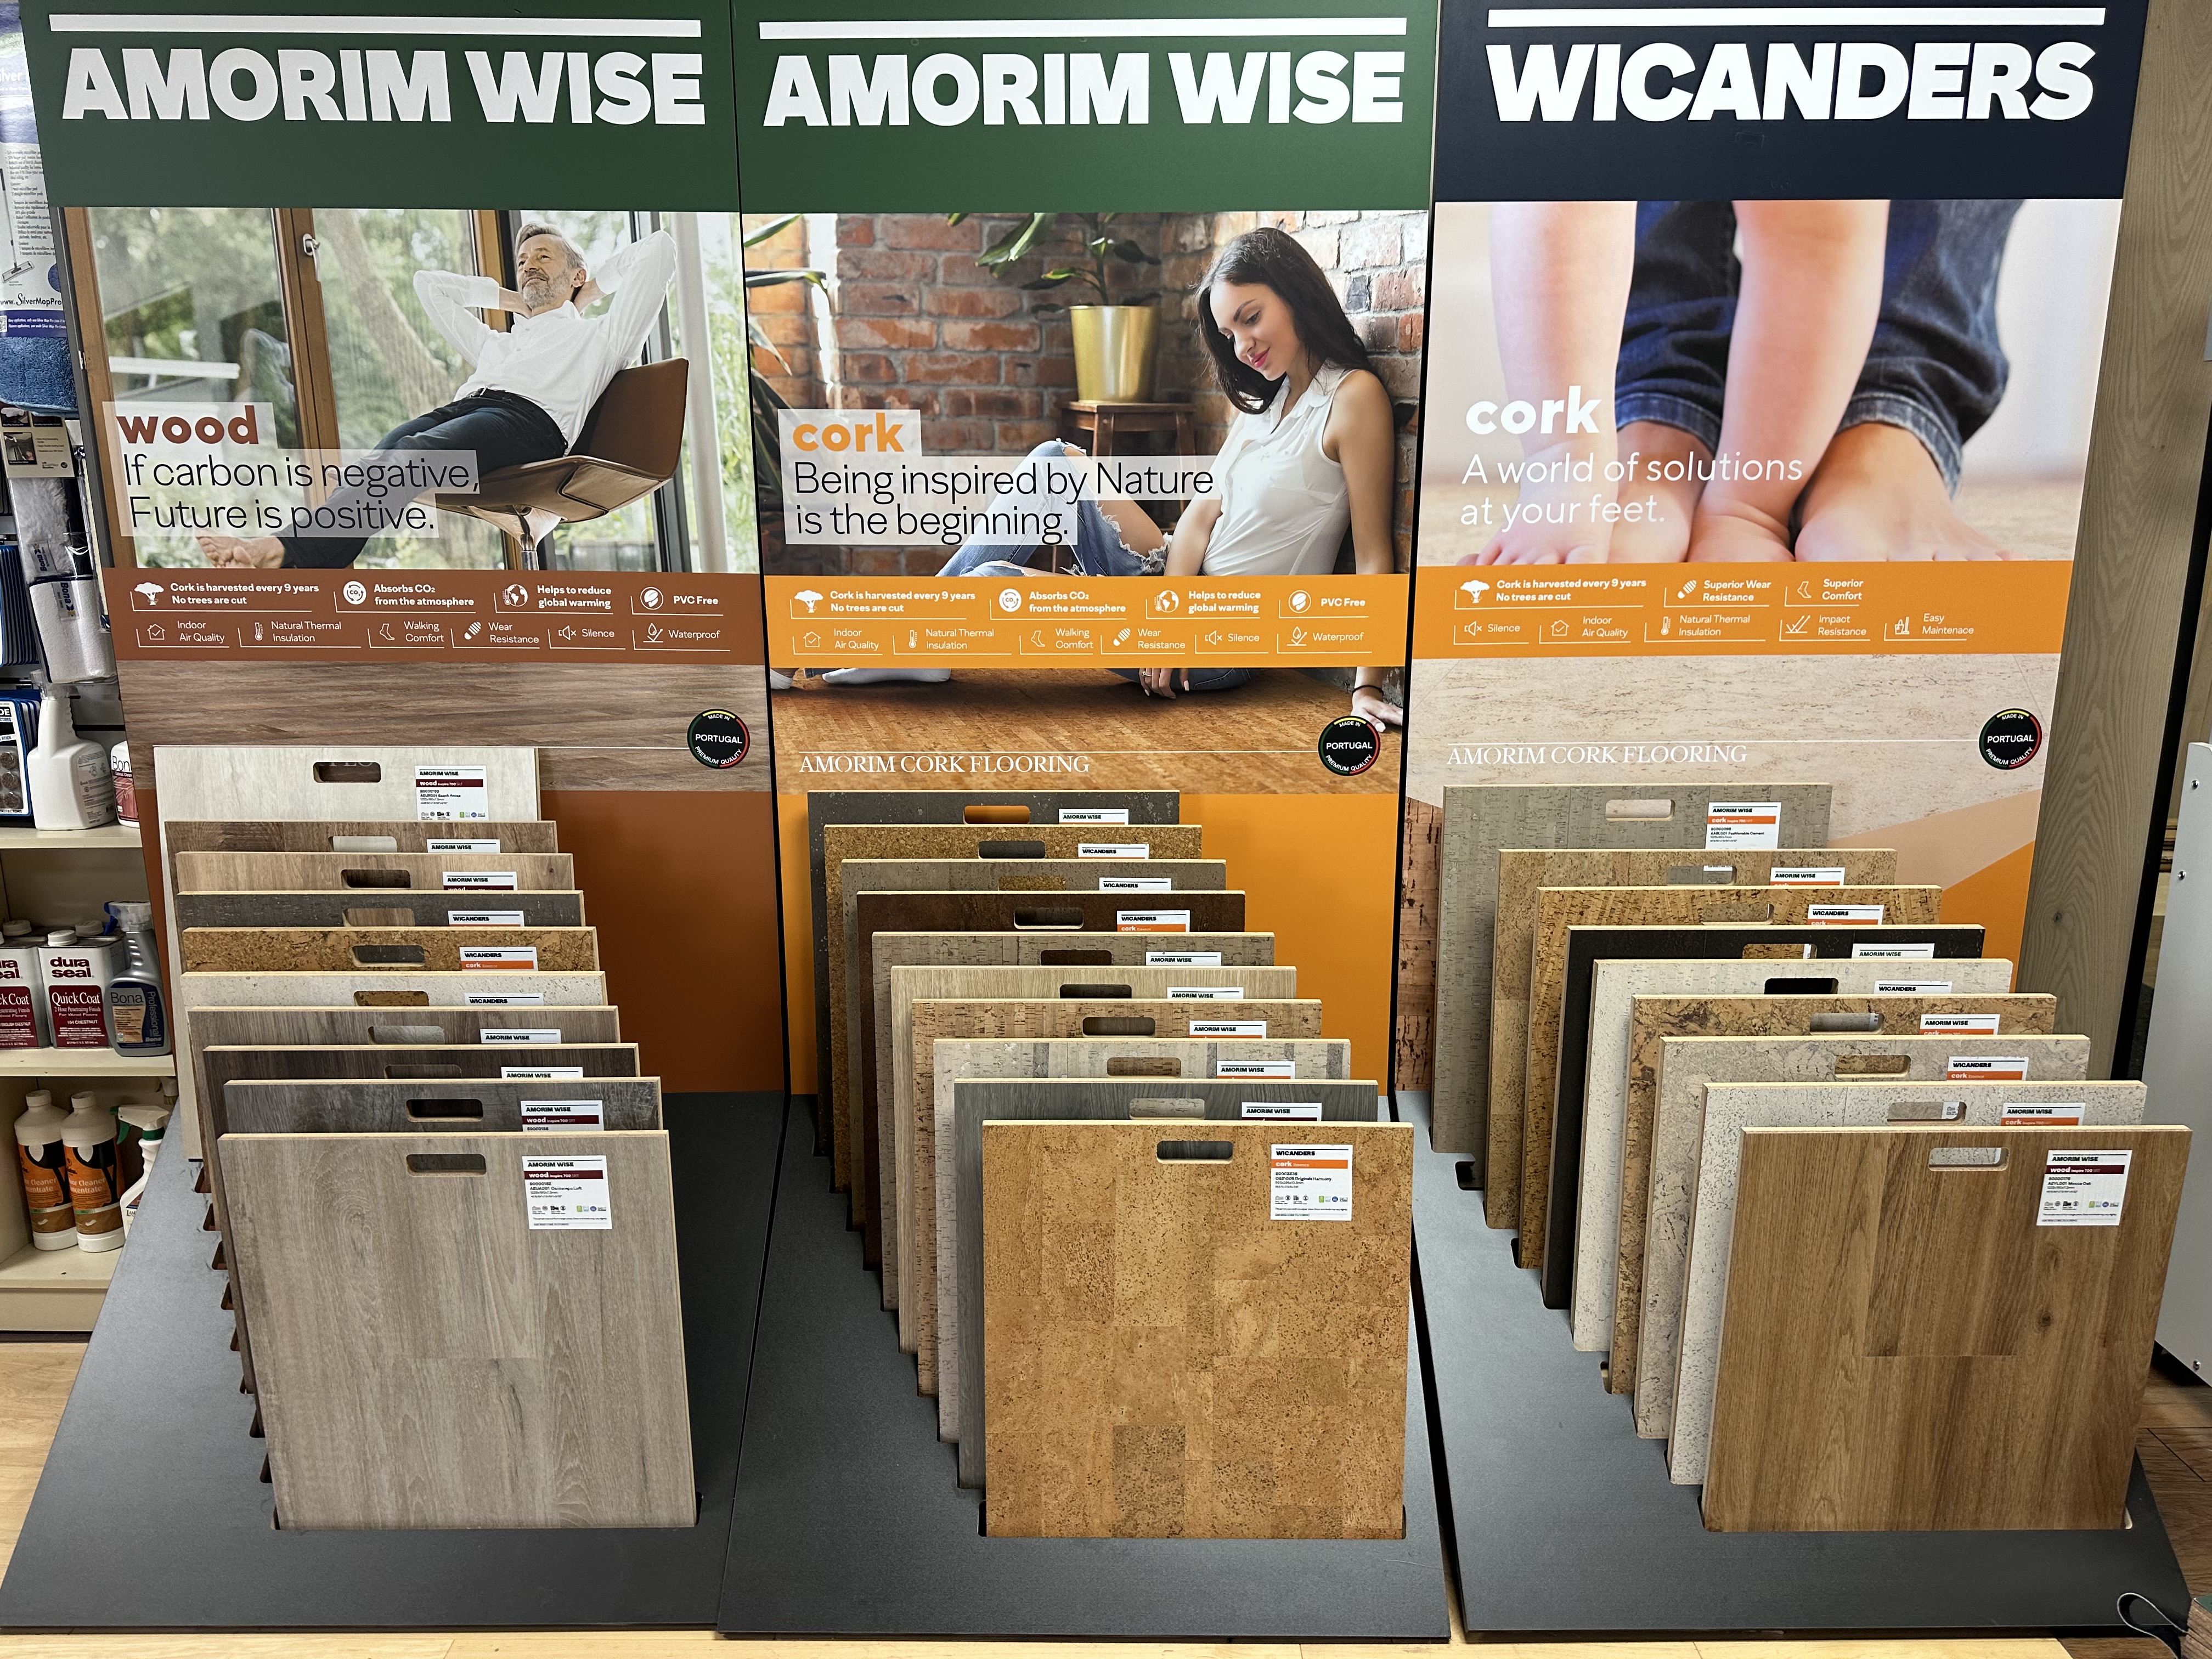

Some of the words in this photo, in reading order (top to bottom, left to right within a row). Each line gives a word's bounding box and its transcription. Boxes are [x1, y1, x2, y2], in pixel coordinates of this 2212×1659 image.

[62, 48, 452, 121] AMORIM
[465, 51, 706, 125] WISE
[1486, 42, 2096, 121] WICANDERS
[763, 52, 1149, 126] AMORIM
[1168, 50, 1406, 124] WISE
[1466, 386, 1602, 435] cork
[116, 405, 259, 444] wood
[792, 413, 904, 452] cork
[1462, 454, 1488, 484] A
[1497, 452, 1594, 483] world
[1604, 452, 1640, 482] of
[1646, 452, 1803, 482] solutions
[124, 454, 148, 486] If
[154, 455, 278, 487] carbon
[286, 458, 313, 487] is
[321, 458, 478, 498] negative,
[795, 462, 894, 505] Being
[902, 462, 1036, 495] inspired
[1047, 462, 1087, 505] by
[1097, 462, 1214, 494] Nature
[130, 496, 247, 529] Future
[256, 499, 282, 529] is
[292, 500, 435, 538] positive.
[1460, 498, 1493, 525] at
[1502, 501, 1580, 532] your
[1590, 494, 1664, 523] feet.
[797, 505, 822, 534] is
[833, 504, 887, 534] the
[898, 504, 1068, 544] beginning.
[171, 583, 195, 592] Cork
[196, 583, 205, 592] is
[206, 583, 255, 592] harvested
[256, 585, 283, 594] every
[284, 584, 291, 592] 9
[292, 585, 319, 594] years
[374, 584, 413, 593] Absorbs
[1497, 580, 1521, 589] Cork
[1522, 580, 1531, 589] is
[1532, 579, 1581, 589] harvested
[1582, 580, 1610, 590] every
[1611, 579, 1618, 588] 9
[1620, 579, 1646, 589] years
[1704, 580, 1744, 590] Superior
[1746, 580, 1771, 589] Wear
[1823, 579, 1864, 590] Superior
[60, 582, 71, 603] Bona
[1189, 591, 1215, 601] Helps
[1217, 591, 1226, 600] to
[1228, 591, 1261, 600] reduce
[1496, 593, 1509, 601] No
[1511, 593, 1536, 601] trees
[1555, 592, 1571, 601] cut
[1703, 592, 1754, 602] Resistance
[1822, 591, 1862, 600] Comfort
[172, 596, 187, 604] No
[188, 596, 212, 605] trees
[230, 596, 247, 605] cut
[375, 596, 397, 605] from
[398, 596, 413, 605] the
[415, 597, 475, 607] atmosphere
[1321, 598, 1342, 607] PVC
[1344, 599, 1365, 607] Free
[1188, 603, 1217, 614] global
[1218, 603, 1259, 614] warming
[1679, 614, 1712, 624] Natural
[1714, 614, 1750, 623] Thermal
[1819, 614, 1850, 625] Impact
[1923, 613, 1944, 624] Easy
[177, 621, 206, 629] Indoor
[404, 621, 439, 632] Walking
[488, 622, 512, 631] Wear
[1922, 625, 1974, 635] Maintenace
[668, 630, 720, 640] Waterproof
[926, 629, 957, 637] Natural
[958, 628, 994, 637] Thermal
[1137, 629, 1161, 637] Wear
[1679, 627, 1721, 636] Insulation
[1818, 627, 1866, 636] Resistance
[195, 633, 224, 644] Quality
[405, 633, 444, 642] Comfort
[490, 635, 539, 644] Resistance
[1228, 633, 1259, 642] Silence
[1313, 633, 1364, 642] Waterproof
[926, 641, 967, 650] Insulation
[1138, 641, 1186, 650] Resistance
[695, 733, 742, 744] PORTUGAL
[1987, 735, 2034, 743] PORTUGAL
[695, 746, 719, 764] PREMIUM
[720, 749, 742, 765] QUALITY
[1447, 747, 1545, 765] AMORIM
[1551, 746, 1617, 764] CORK
[1622, 745, 1747, 763] FLOORING
[1986, 748, 2008, 765] PREMIUM
[2010, 747, 2033, 764] QUALITY
[799, 755, 896, 772] AMORIM
[901, 755, 965, 772] CORK
[969, 755, 1090, 772] FLOORING
[1325, 755, 1349, 771] PREMIUM
[1351, 754, 1372, 771] QUALITY
[50, 957, 89, 967] dura
[52, 968, 91, 978] seal
[52, 992, 79, 1007] Quick
[80, 992, 101, 1004] Coat
[111, 992, 144, 1003] Bona
[146, 991, 160, 1037] Professional
[78, 1178, 106, 1186] Cleaner
